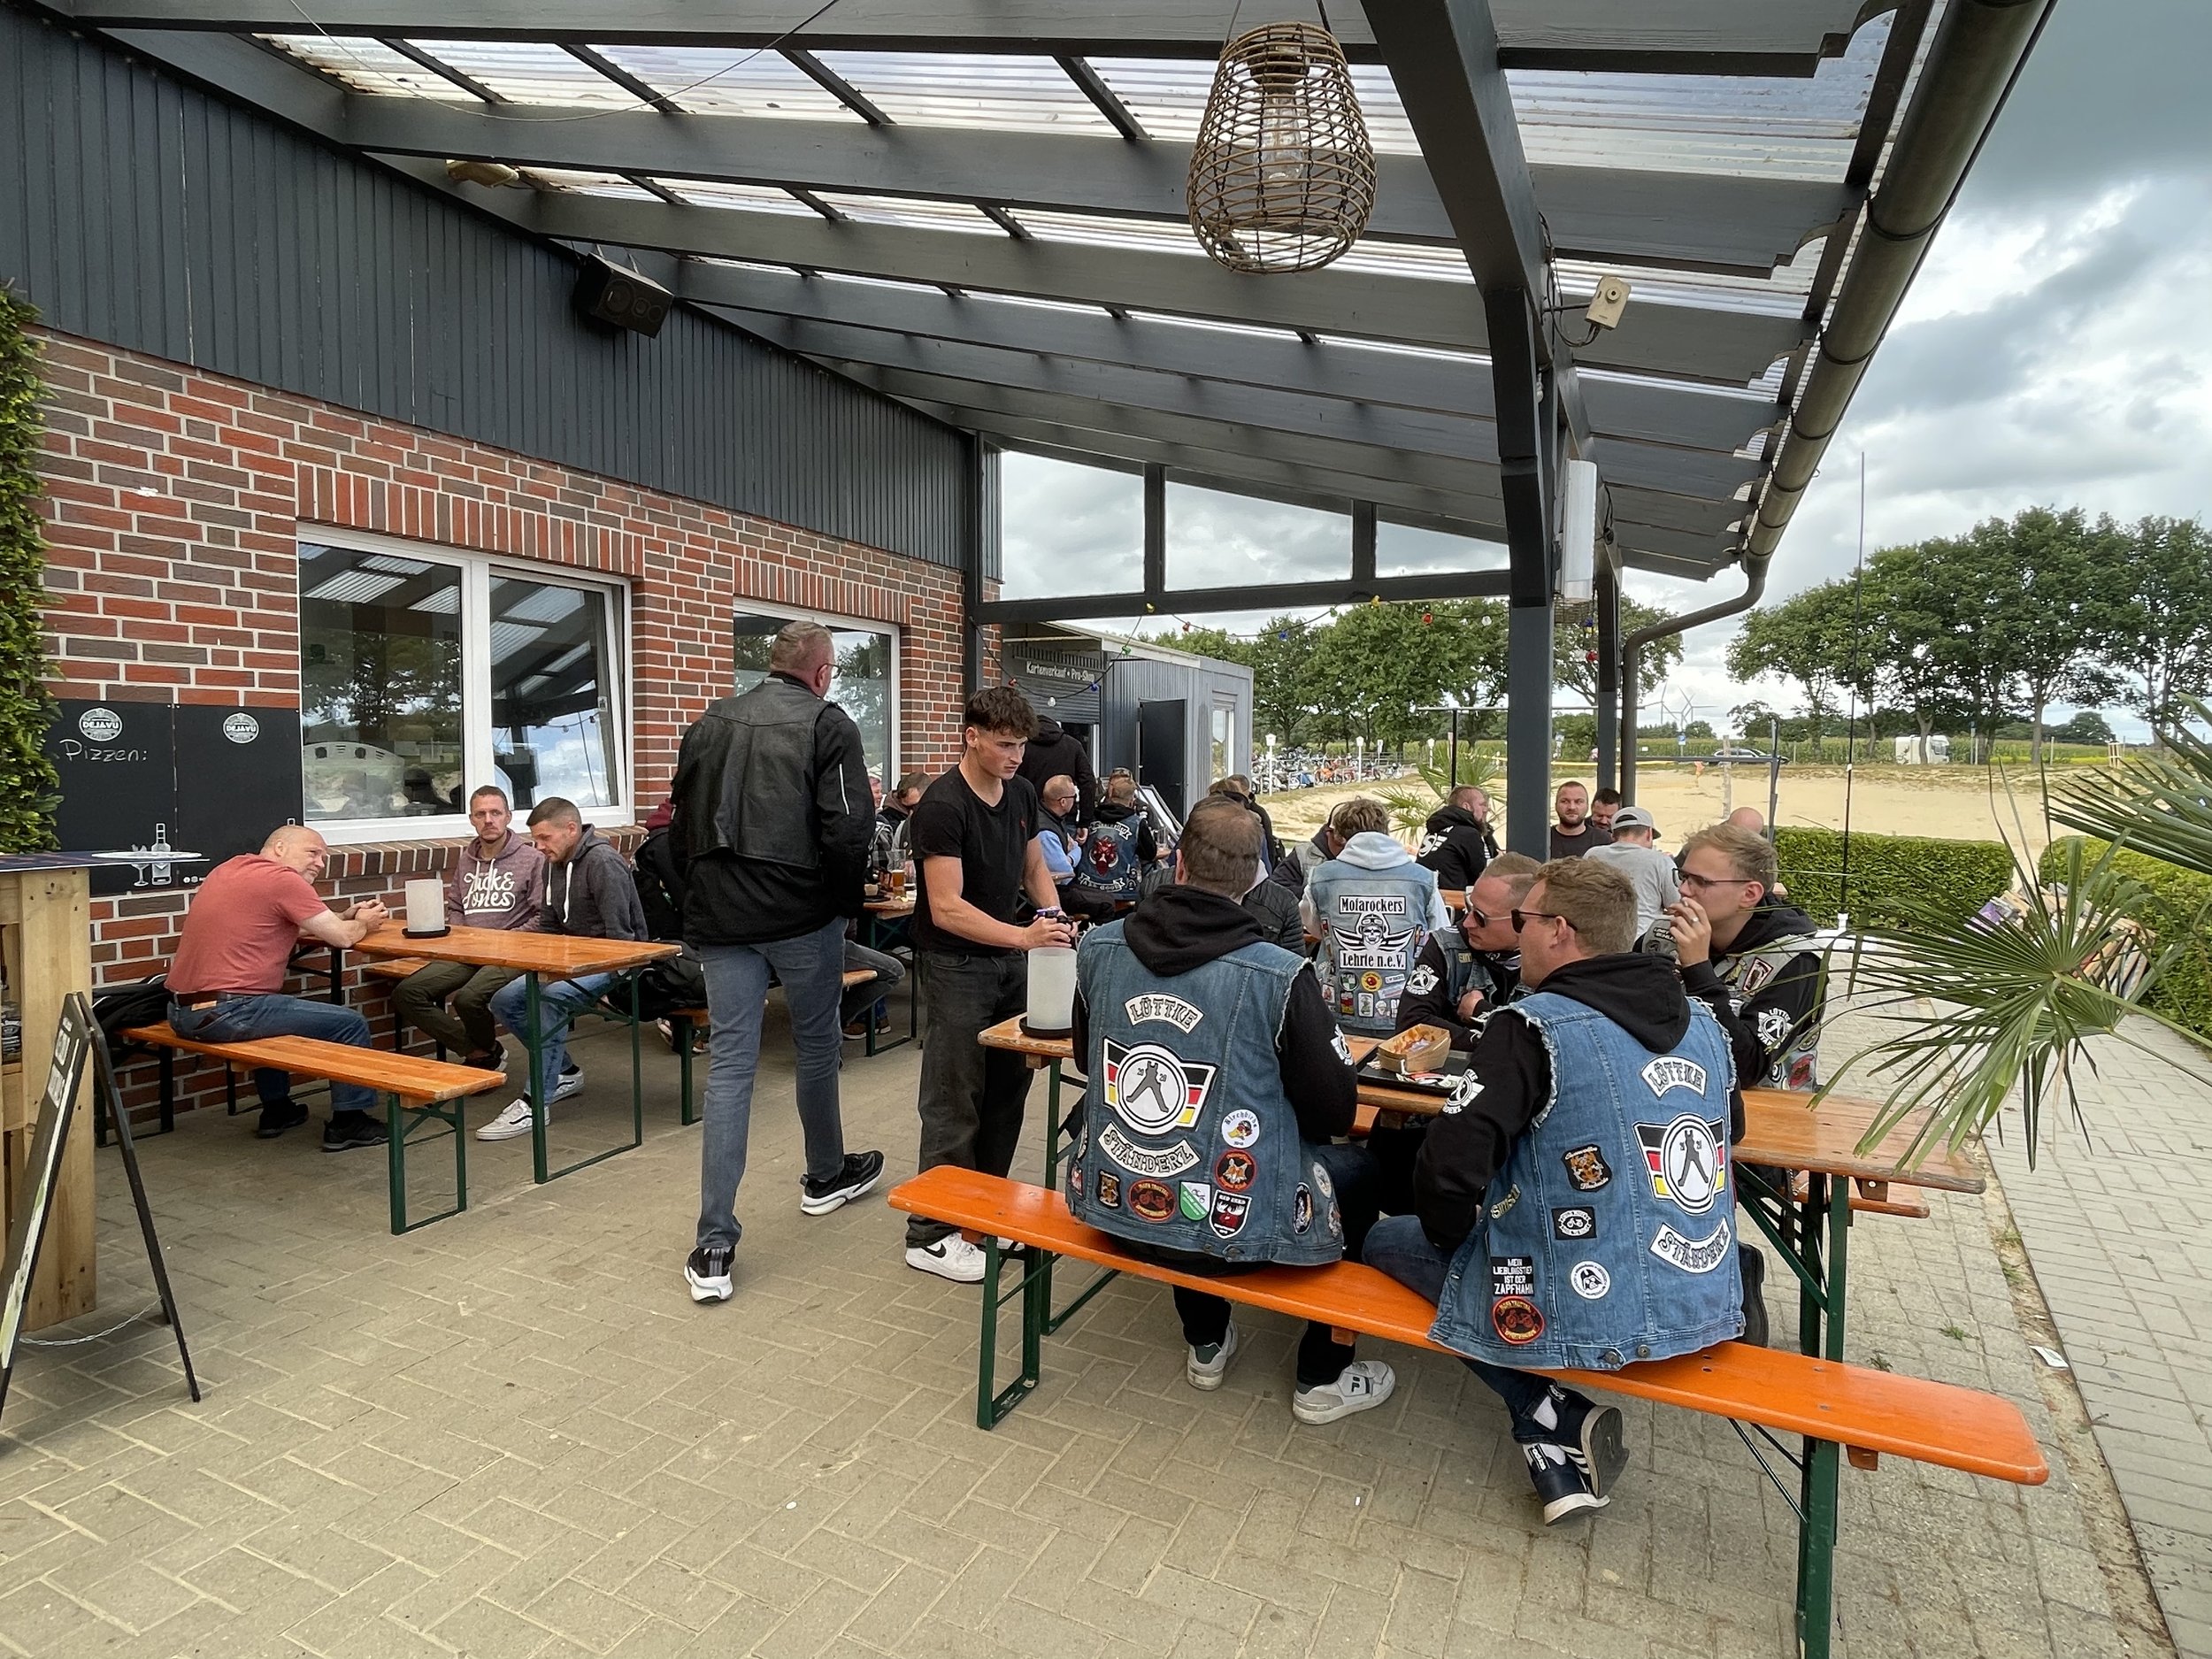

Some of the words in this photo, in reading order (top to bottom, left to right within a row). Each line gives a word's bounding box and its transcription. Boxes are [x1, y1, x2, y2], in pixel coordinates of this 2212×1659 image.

[59, 738, 147, 762] Pizzen:
[1340, 897, 1403, 912] Mofarockers
[1342, 952, 1374, 967] Lehrte
[1377, 954, 1404, 968] n.e.V.
[1129, 996, 1199, 1030] LÜTTKE
[1647, 1061, 1704, 1093] LÜTTKE
[1102, 1129, 1194, 1173] STÄNDERZ
[1657, 1224, 1729, 1270] STÄNDERZ
